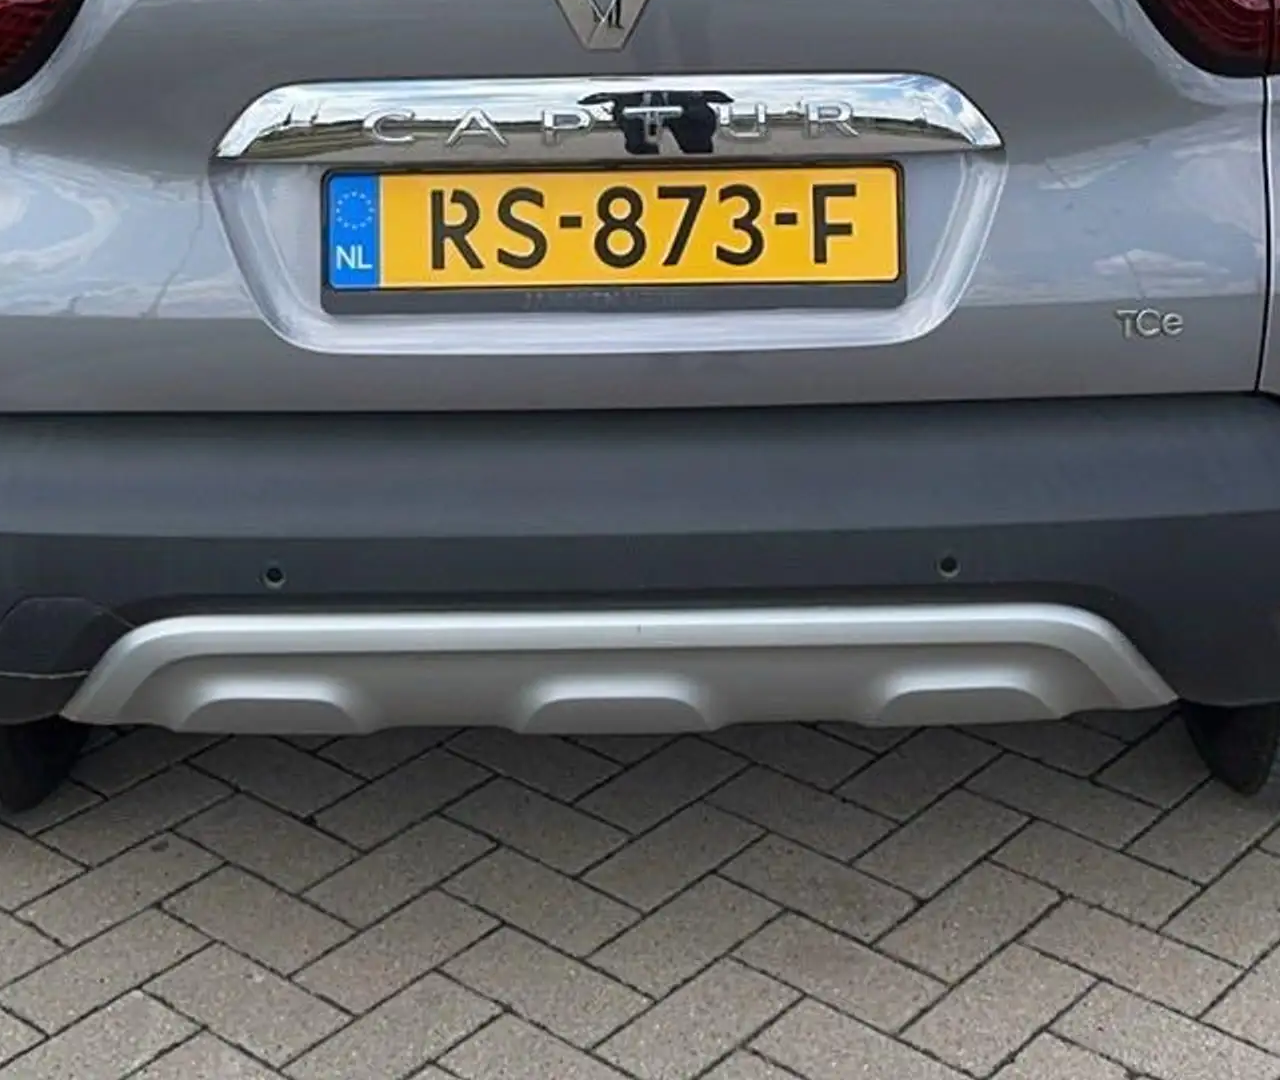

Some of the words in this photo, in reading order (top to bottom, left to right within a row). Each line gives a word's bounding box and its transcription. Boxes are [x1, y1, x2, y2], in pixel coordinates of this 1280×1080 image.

[362, 101, 860, 148] CAPTUR
[430, 183, 858, 270] RS-873-F
[335, 244, 373, 270] NL
[1115, 307, 1184, 339] TCe
